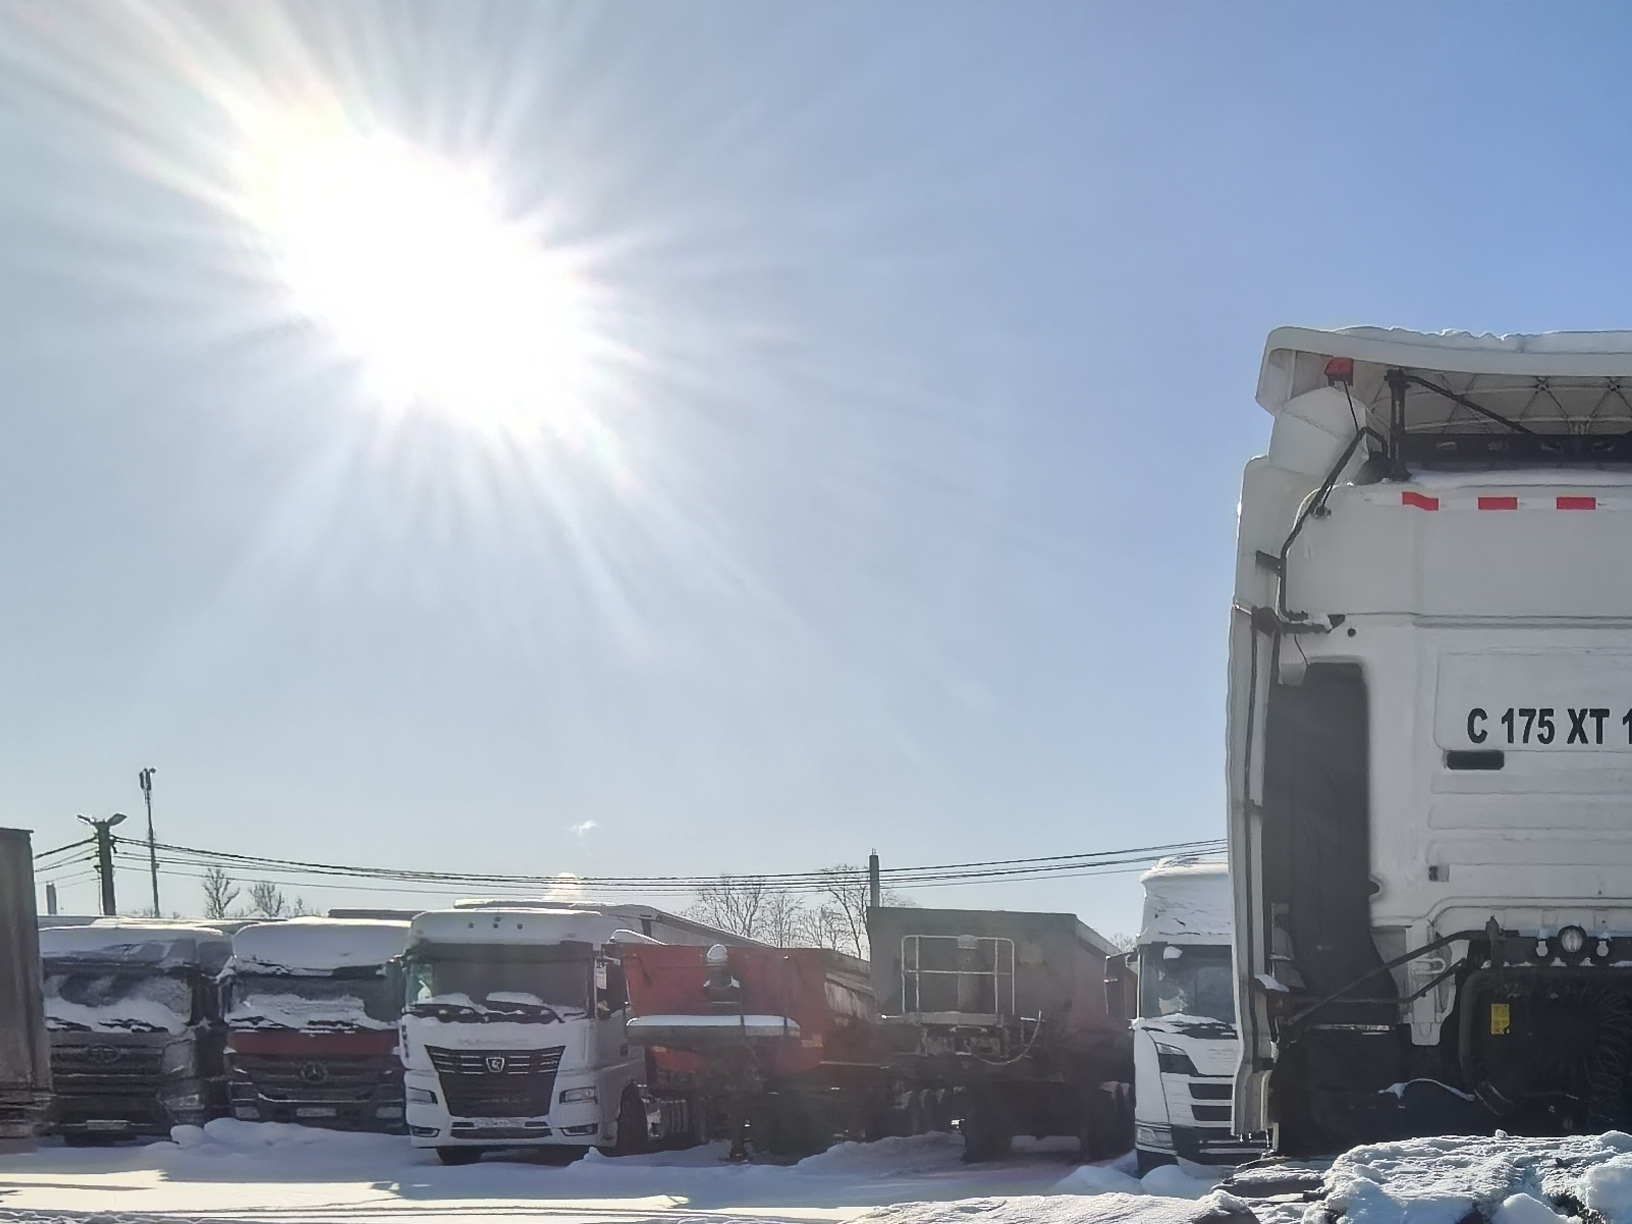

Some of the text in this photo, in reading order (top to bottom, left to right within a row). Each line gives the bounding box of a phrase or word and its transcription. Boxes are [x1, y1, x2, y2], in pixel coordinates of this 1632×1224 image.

[1467, 707, 1488, 744] С
[1501, 707, 1555, 744] 175
[1566, 707, 1610, 744] ХТ
